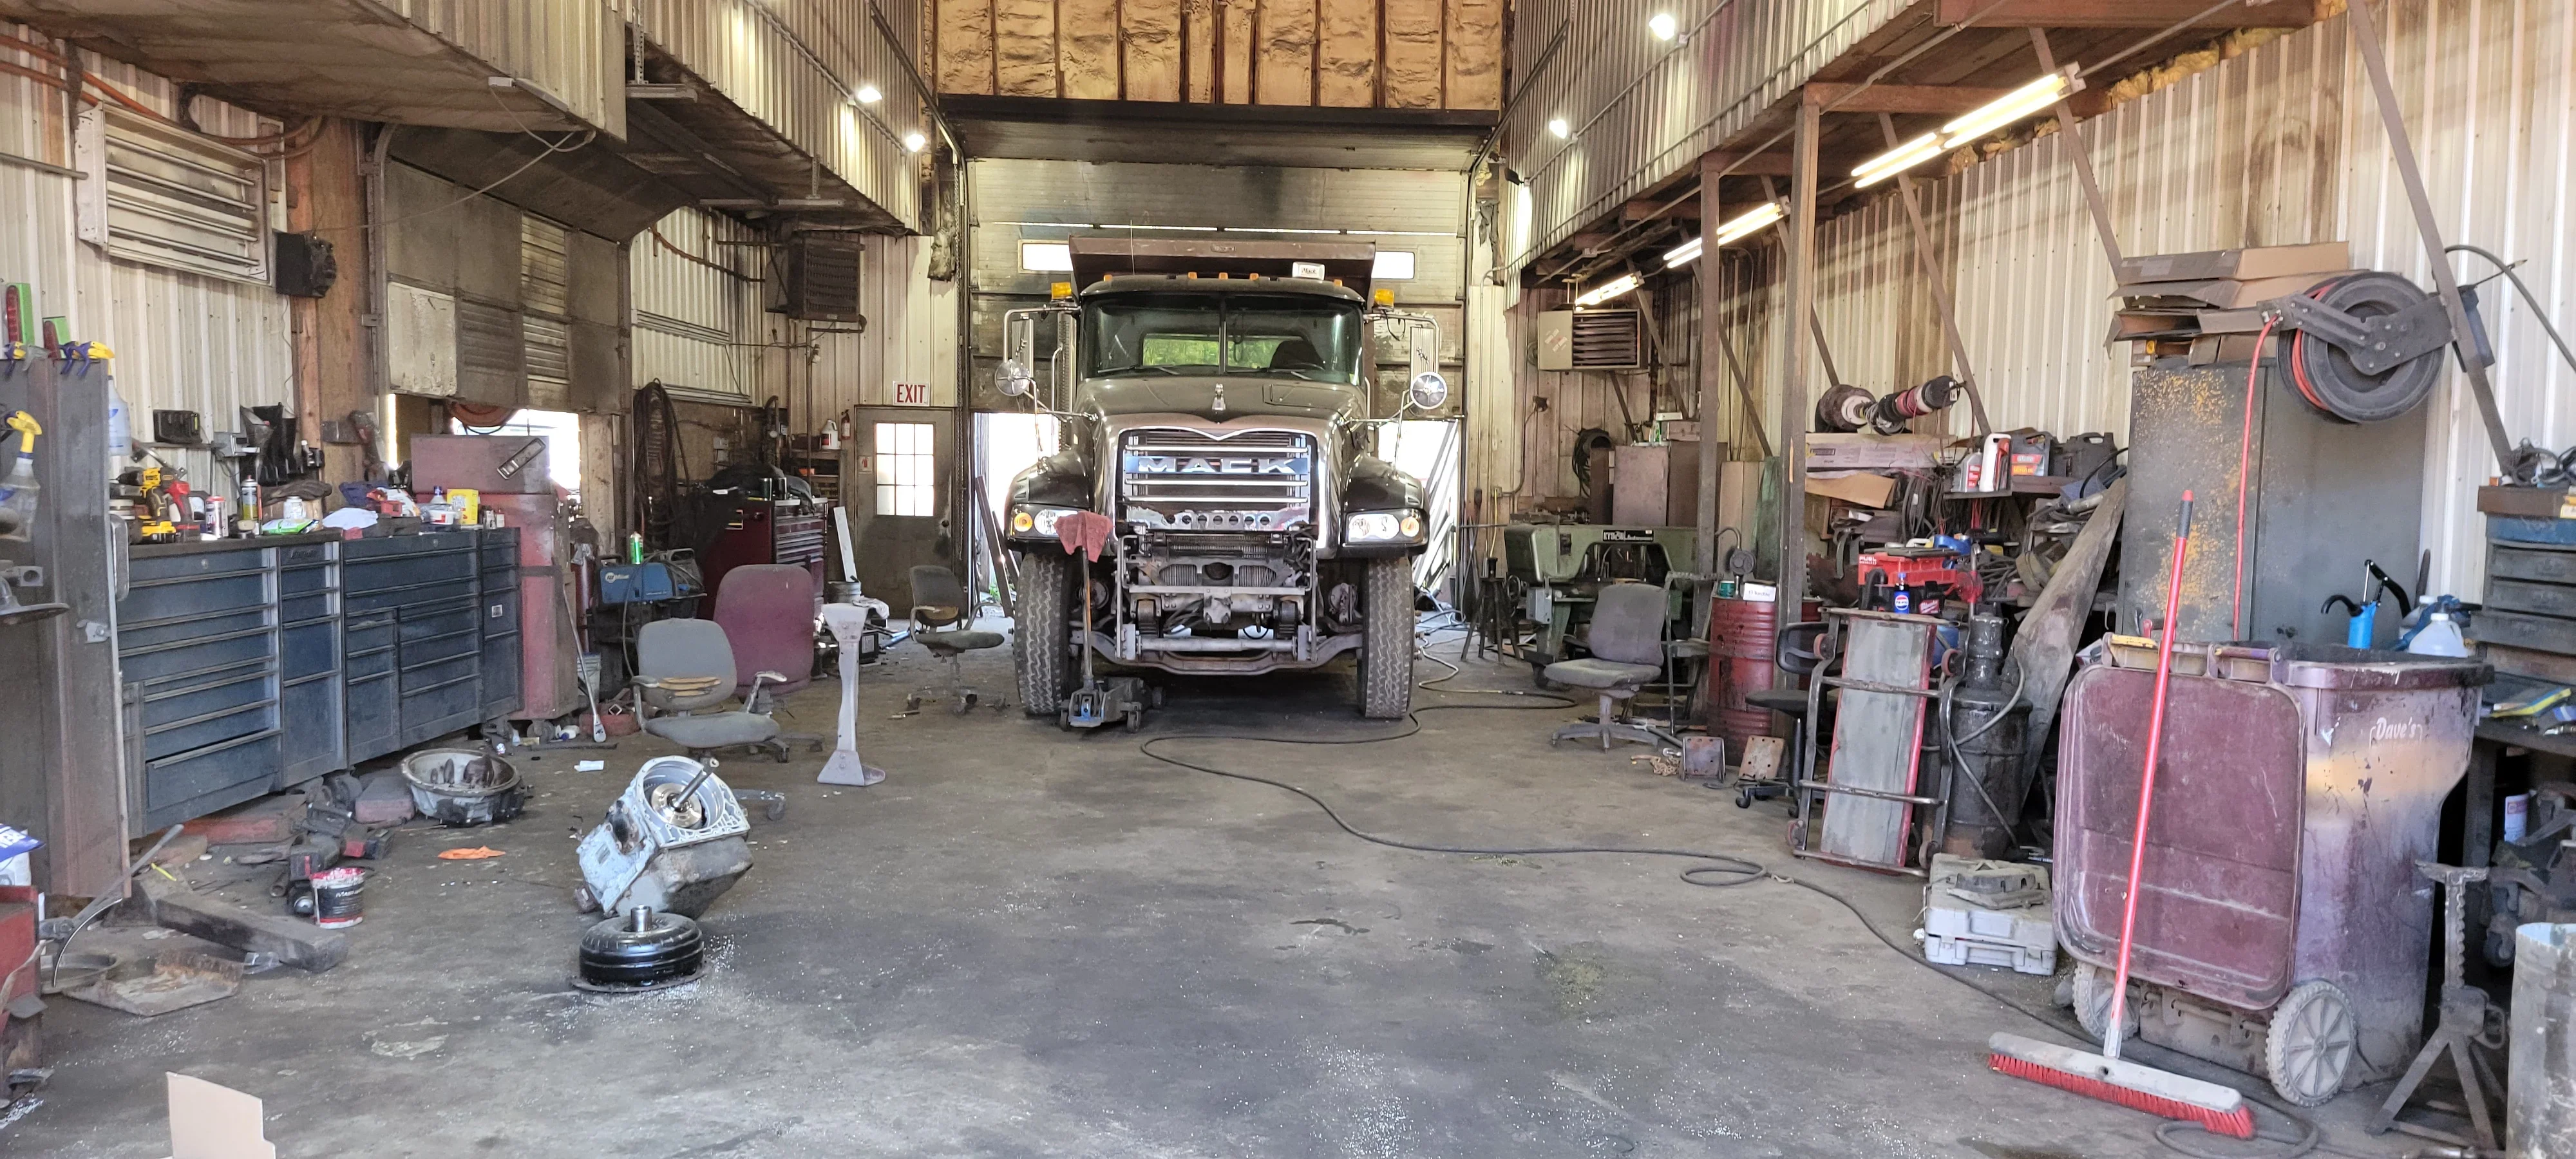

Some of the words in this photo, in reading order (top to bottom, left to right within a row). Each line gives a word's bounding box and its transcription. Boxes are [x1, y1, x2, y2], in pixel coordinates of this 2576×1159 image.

[897, 384, 926, 404] EXIT
[1139, 457, 1296, 473] MACK
[2376, 716, 2417, 740] Dave's
